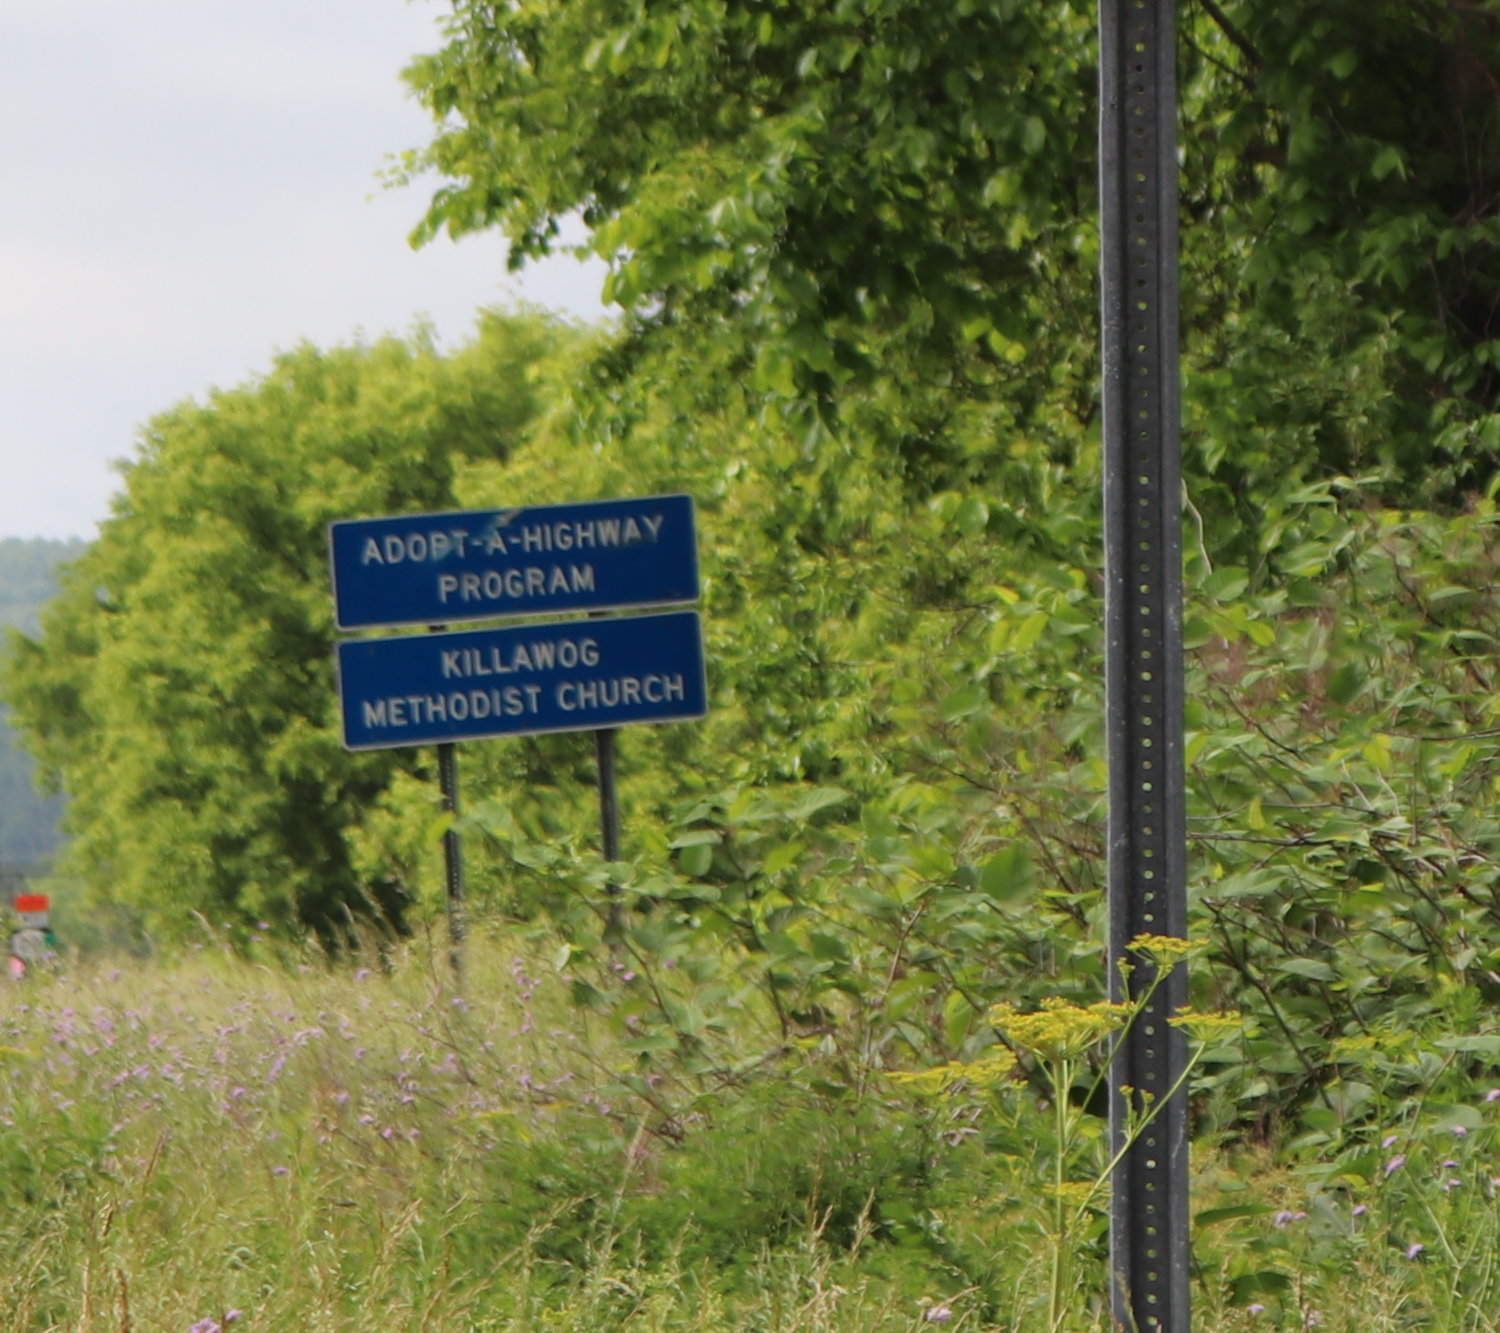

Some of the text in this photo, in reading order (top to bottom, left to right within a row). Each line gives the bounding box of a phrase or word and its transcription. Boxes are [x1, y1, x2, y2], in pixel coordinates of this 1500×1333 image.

[362, 515, 664, 566] ADOPT-A-HIGHWAY
[438, 564, 596, 603] PROGRAM
[441, 638, 600, 679] KILLAWOG
[363, 674, 685, 728] METHODIST CHURCH
